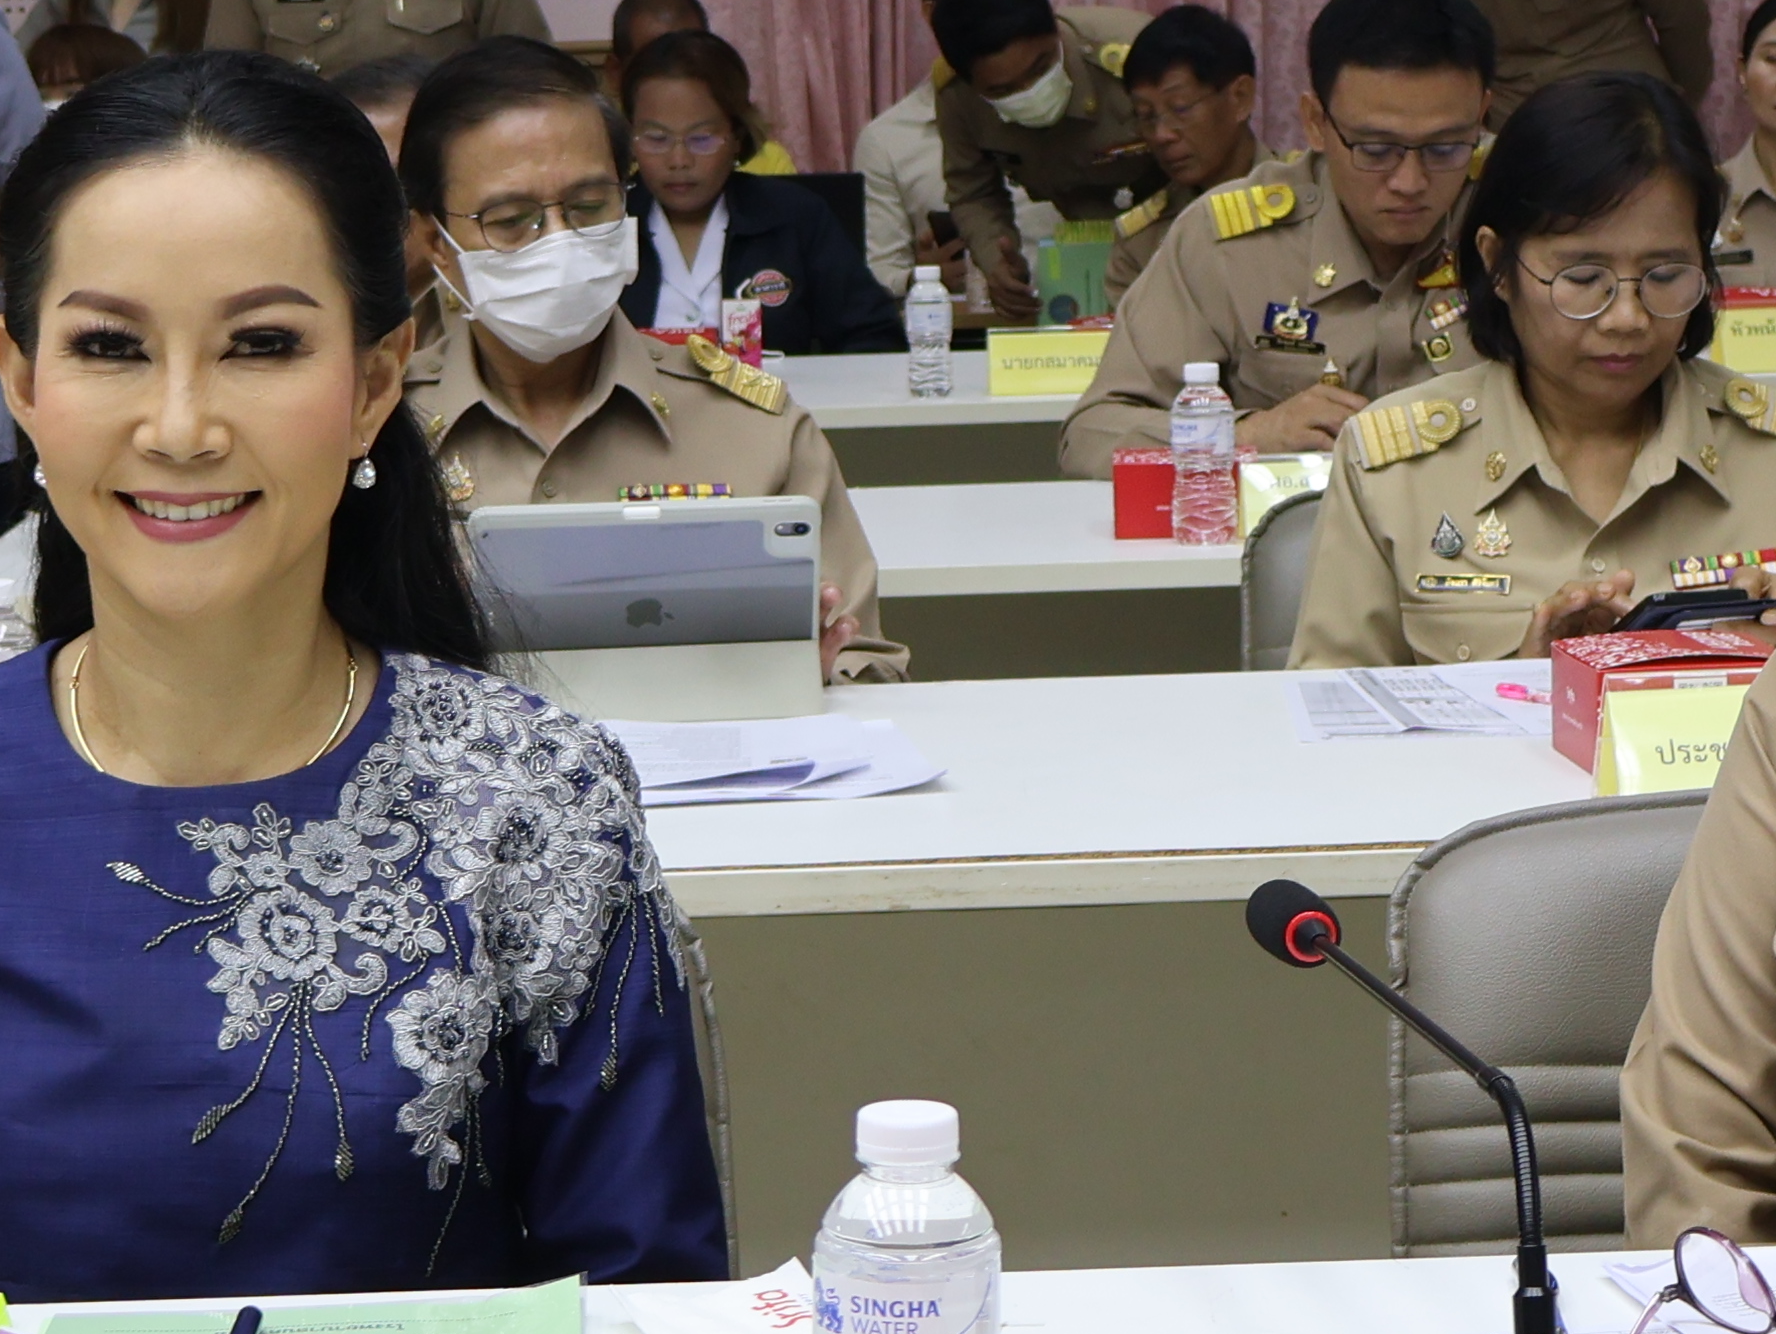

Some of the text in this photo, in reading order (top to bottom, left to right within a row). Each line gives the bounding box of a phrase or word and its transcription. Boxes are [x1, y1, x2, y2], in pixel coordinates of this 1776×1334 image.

[1002, 355, 1100, 371] นายกสมาคม
[850, 1295, 941, 1319] SINGHA
